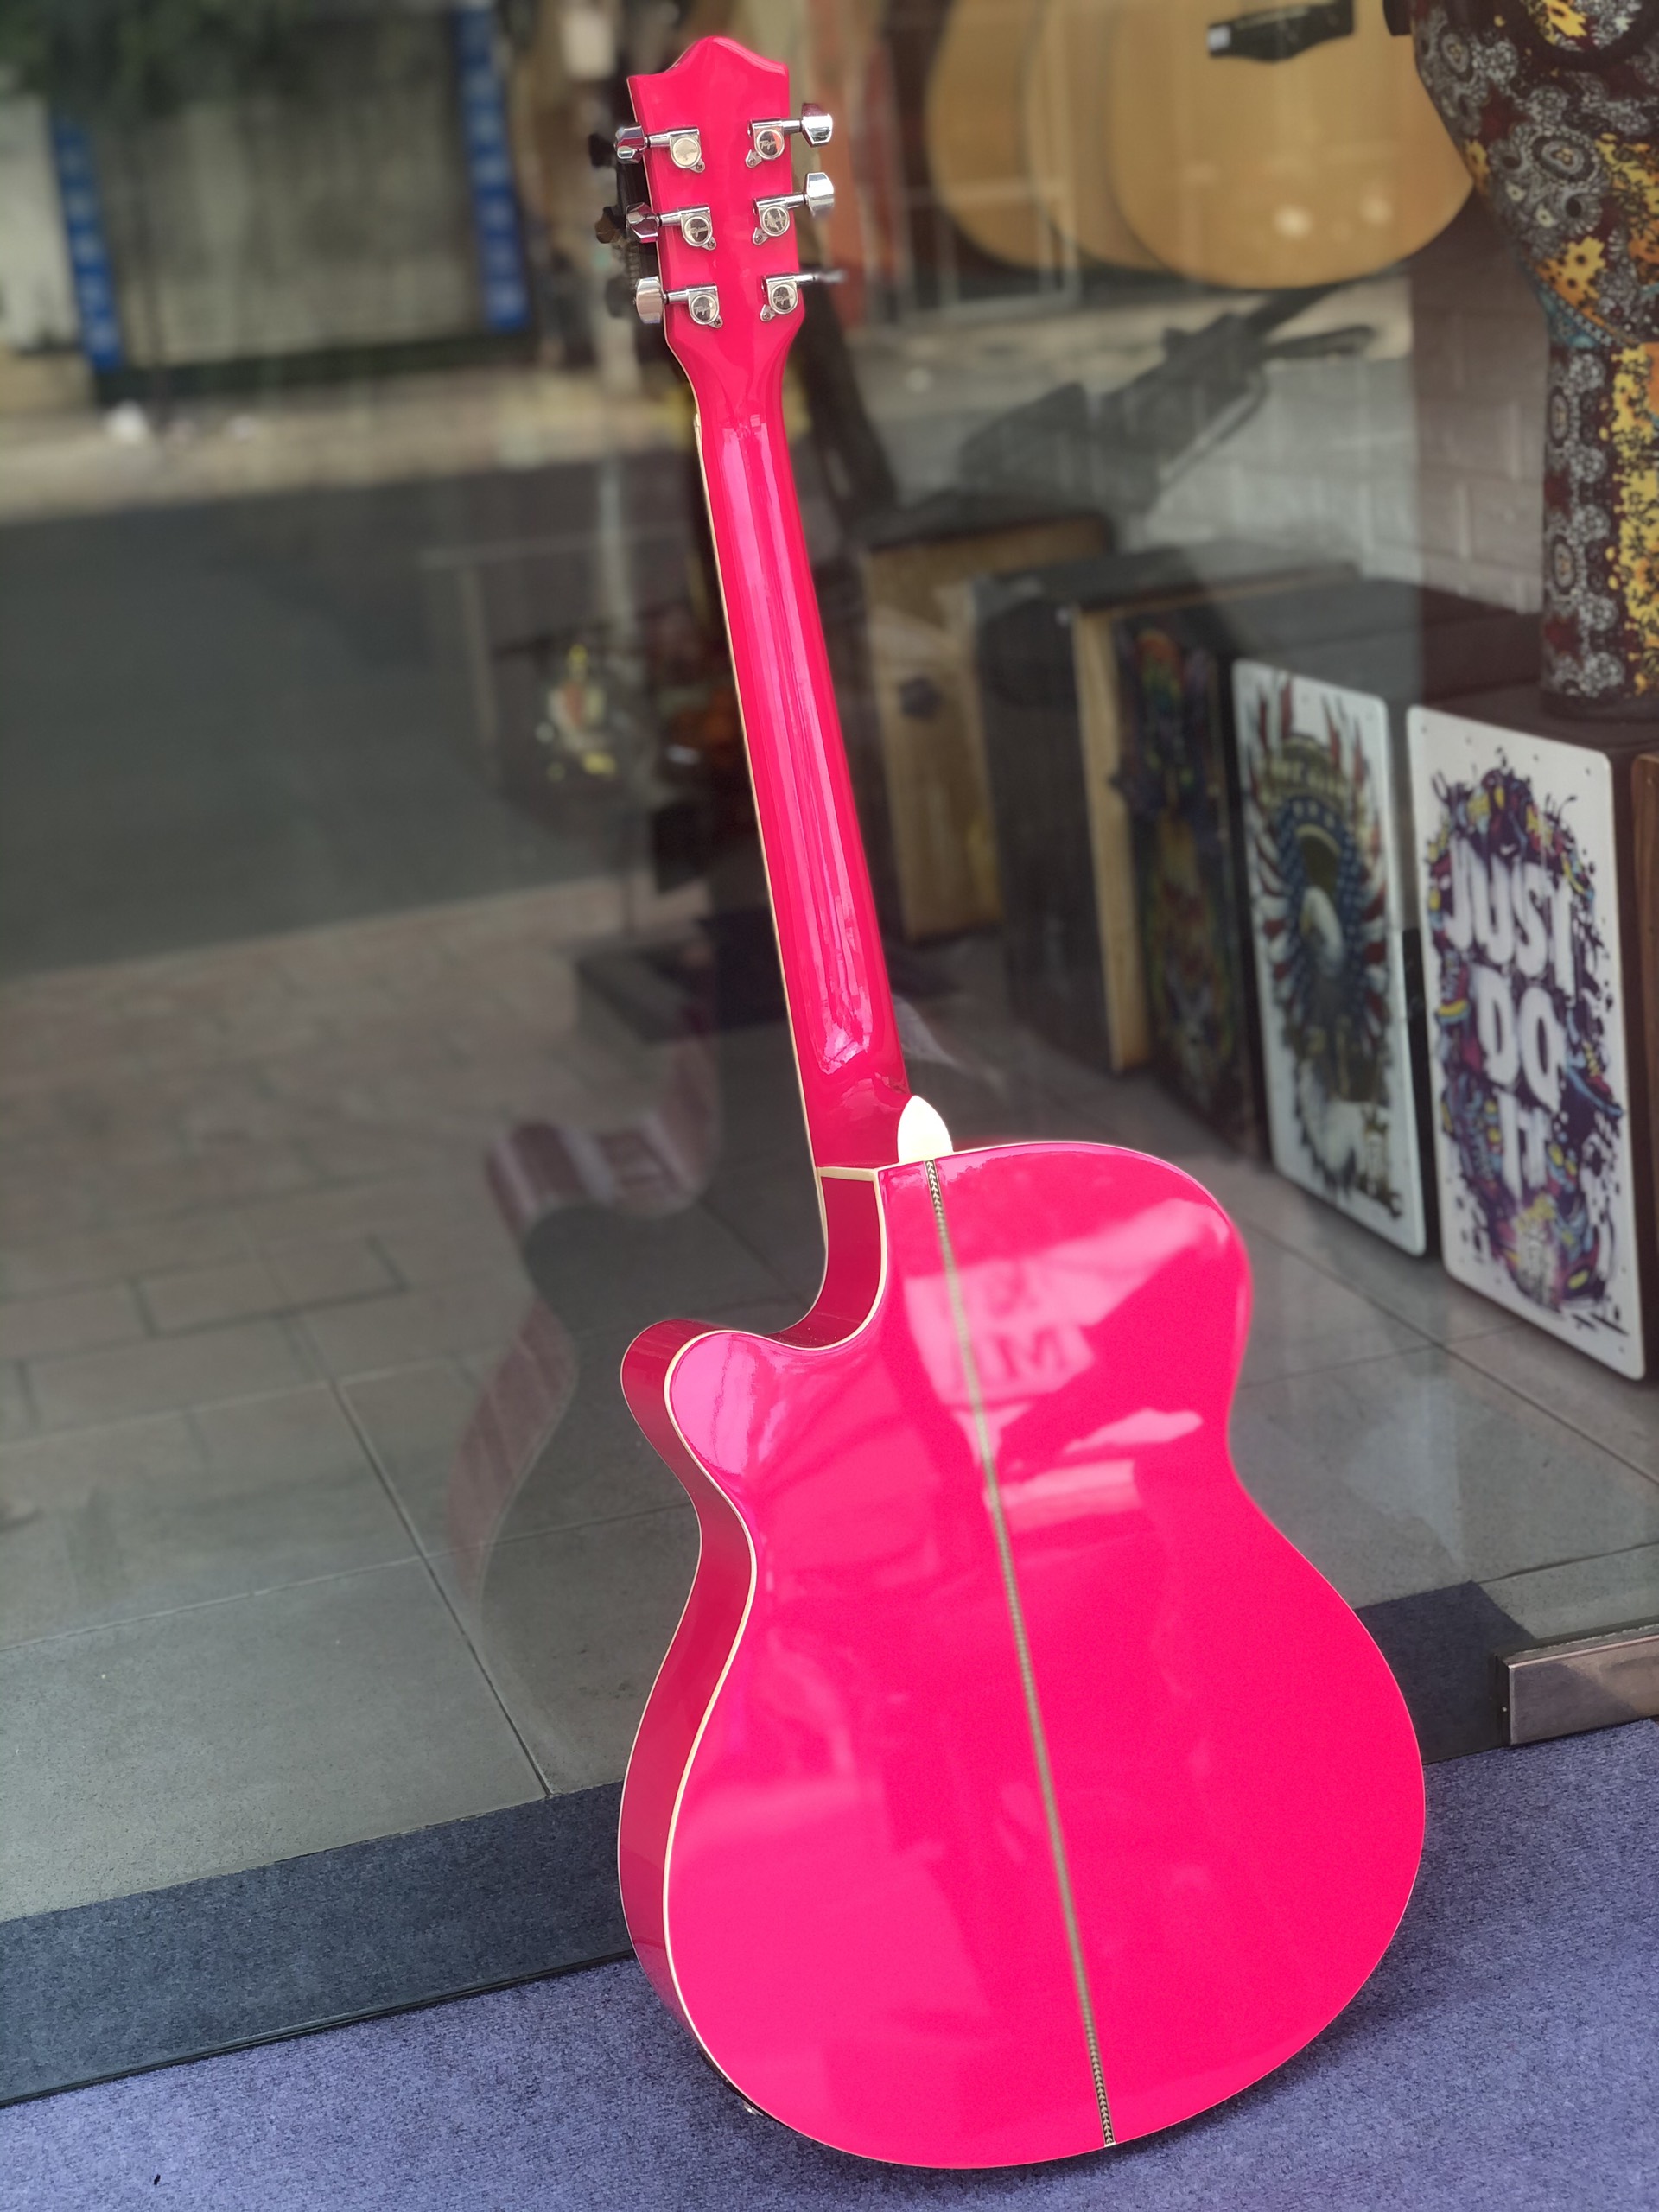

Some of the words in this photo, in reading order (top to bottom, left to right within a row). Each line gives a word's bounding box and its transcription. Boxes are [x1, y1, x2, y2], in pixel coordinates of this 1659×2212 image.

[1444, 836, 1576, 1003] JUST
[1471, 965, 1564, 1115] DO
[1496, 1089, 1552, 1200] IT
